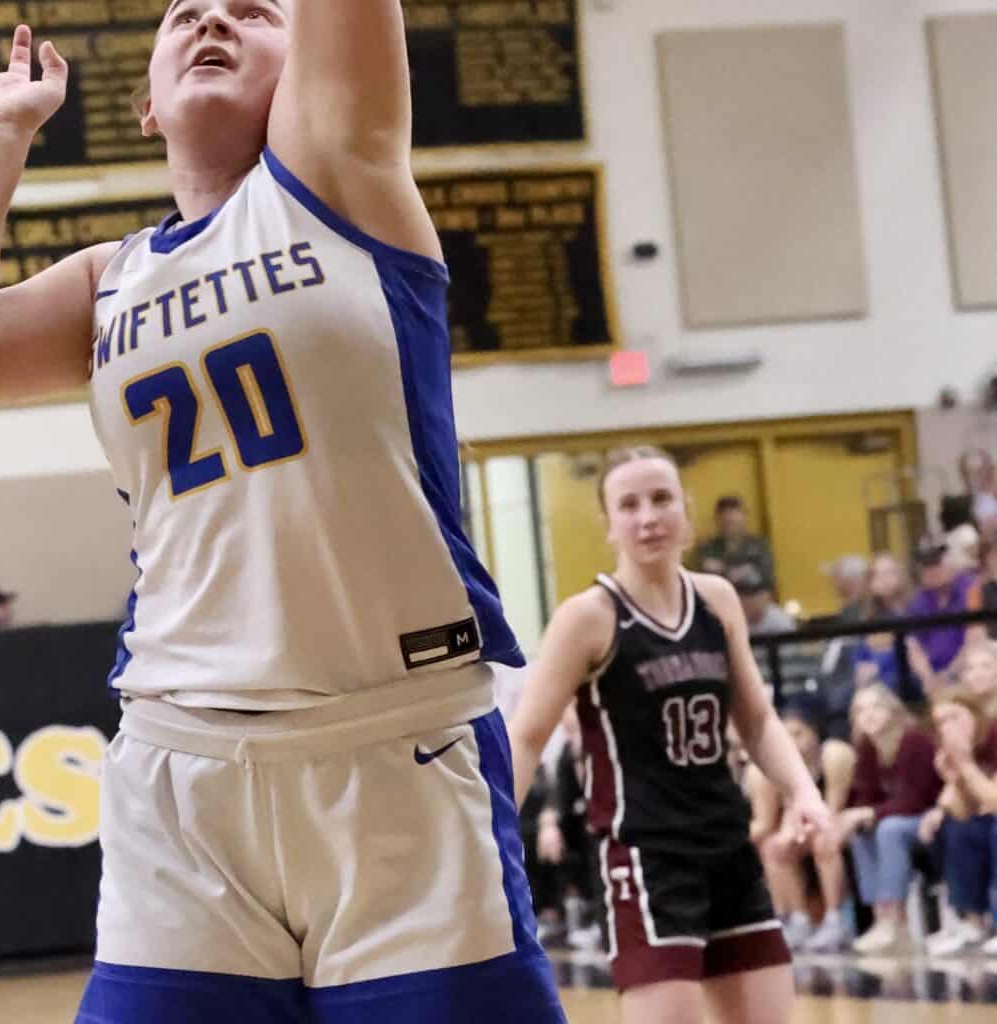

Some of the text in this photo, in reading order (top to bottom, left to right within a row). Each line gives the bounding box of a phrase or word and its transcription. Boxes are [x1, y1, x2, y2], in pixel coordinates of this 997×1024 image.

[93, 241, 325, 369] WIFTETTES
[119, 327, 309, 503] 20
[662, 693, 723, 766] 13
